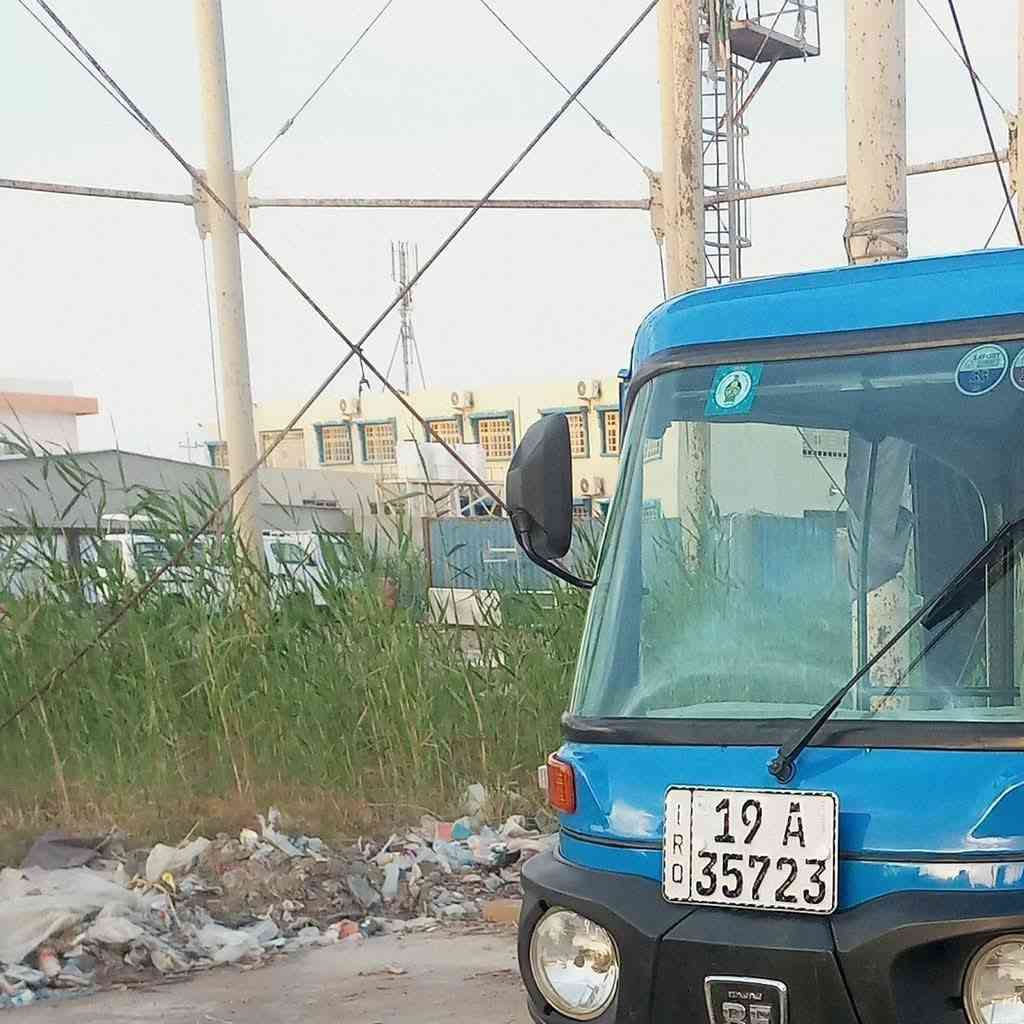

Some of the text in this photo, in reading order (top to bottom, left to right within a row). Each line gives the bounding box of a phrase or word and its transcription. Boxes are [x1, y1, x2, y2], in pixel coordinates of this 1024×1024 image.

[714, 798, 806, 848] 19 A
[696, 850, 827, 904] 35723
